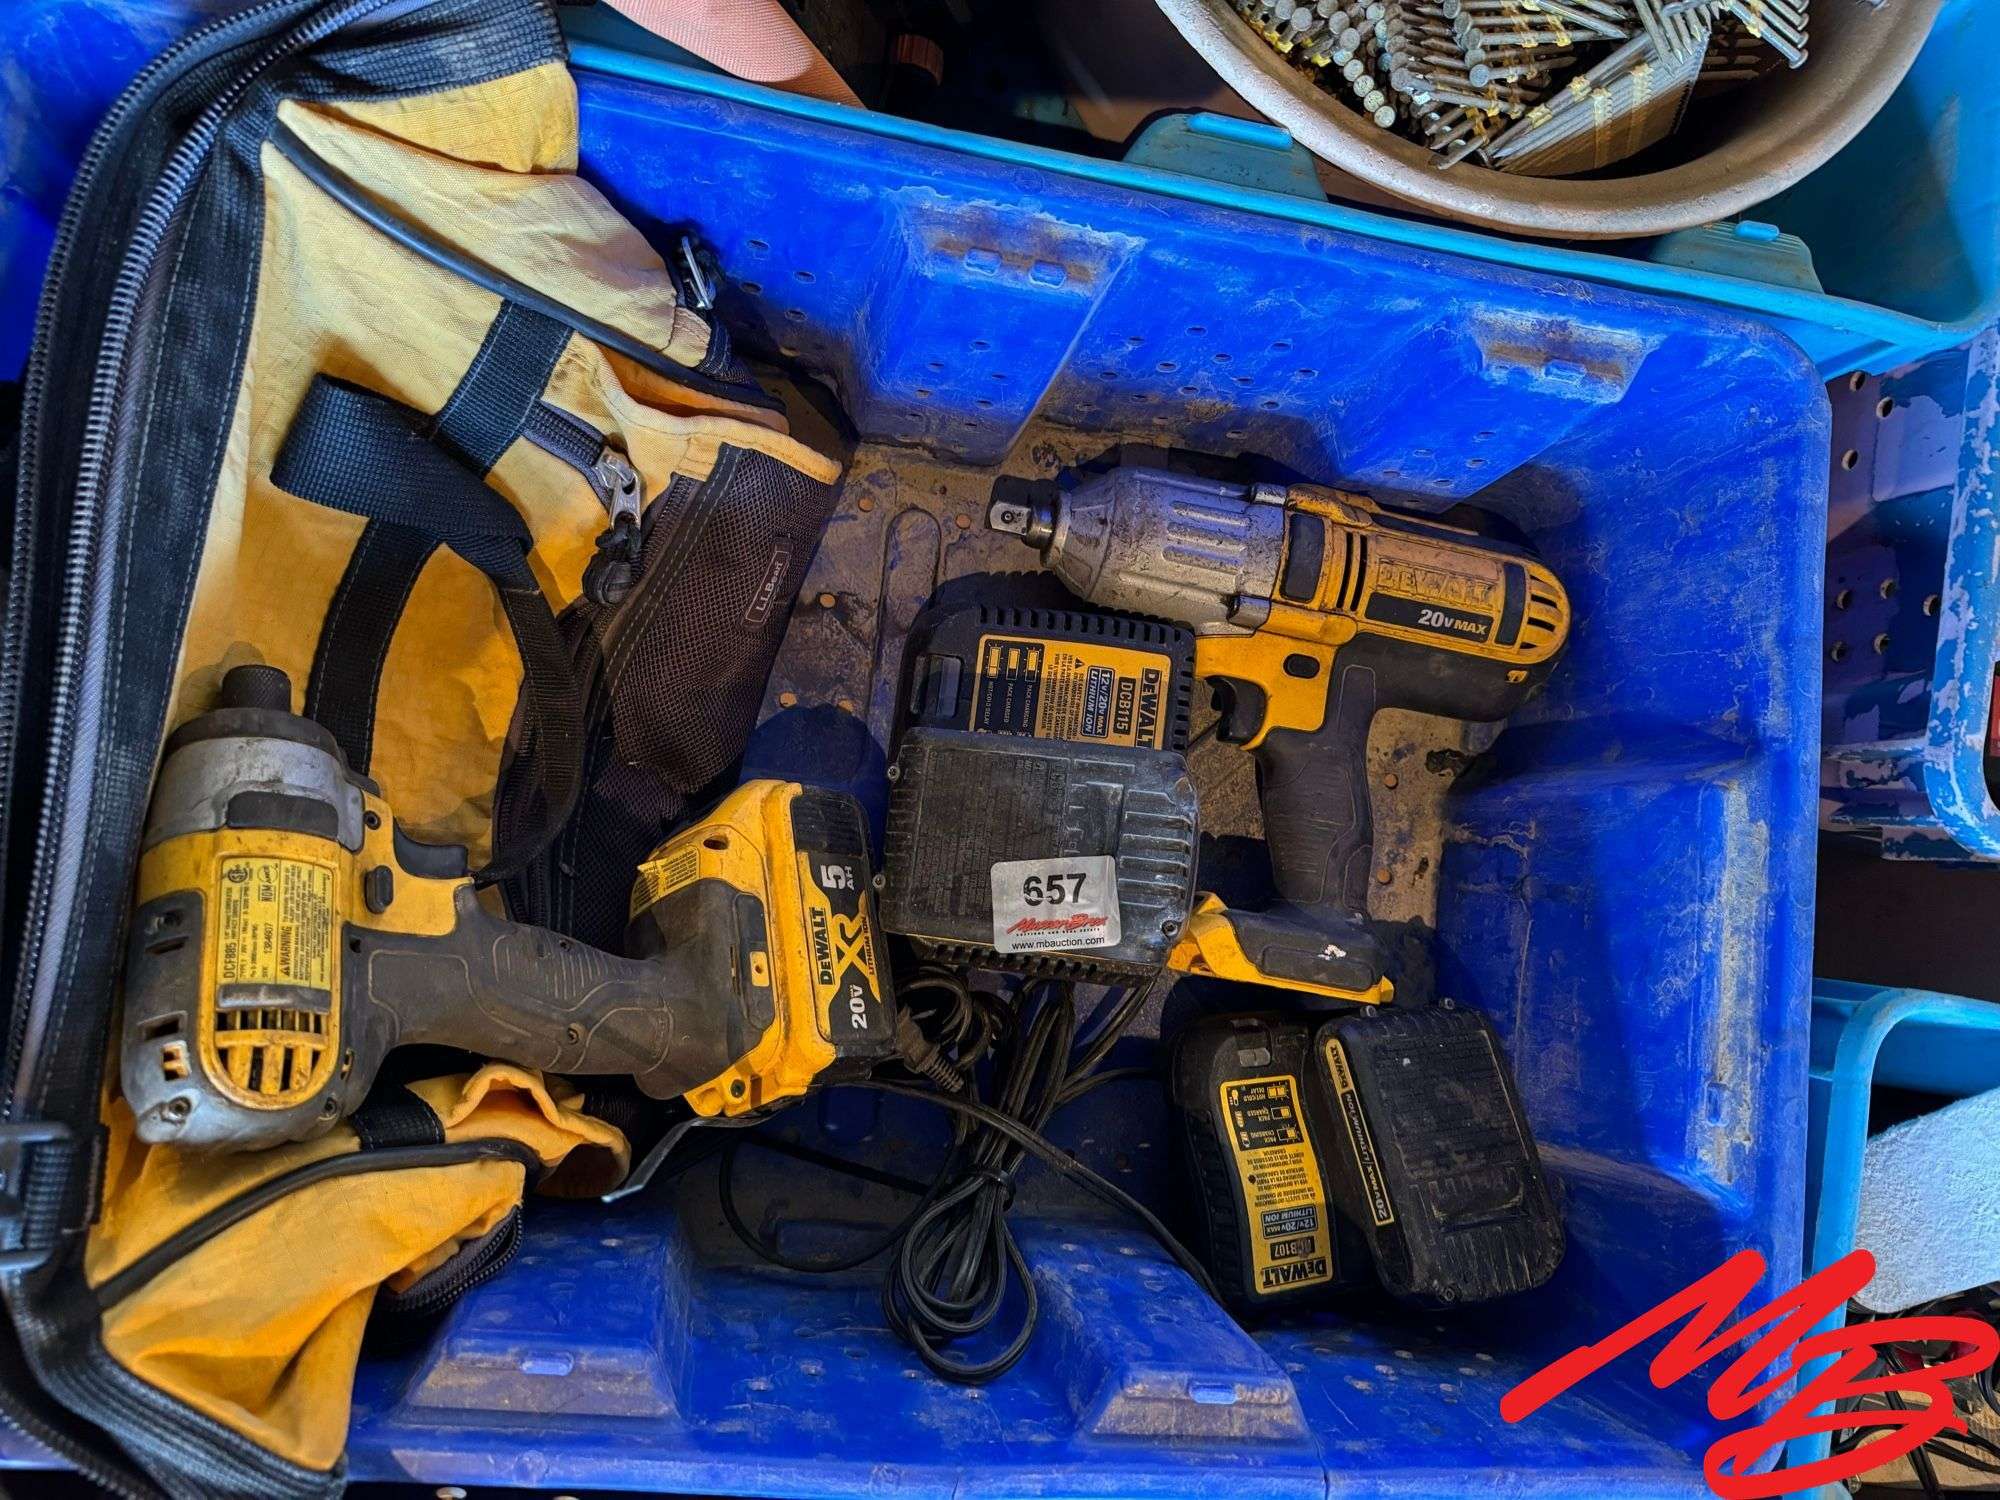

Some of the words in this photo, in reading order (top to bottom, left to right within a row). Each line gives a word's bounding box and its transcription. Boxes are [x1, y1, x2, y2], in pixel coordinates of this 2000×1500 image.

[1454, 620, 1487, 634] MAX
[1087, 671, 1098, 711] LITHIUM
[1117, 682, 1131, 730] DCB115
[1084, 713, 1093, 732] ION
[1096, 715, 1104, 734] MAX
[820, 864, 846, 889] 5
[1023, 872, 1087, 906] 657
[860, 916, 869, 935] ION
[280, 926, 292, 967] WARNING
[812, 907, 832, 985] DEWALT
[863, 935, 875, 975] LITHIUM
[1011, 937, 1105, 950] www.mbauction.com
[224, 942, 237, 979] DCF885
[1330, 1045, 1348, 1088] DEWALT
[1265, 1213, 1279, 1222] ION
[1281, 1208, 1313, 1220] LITHIUM
[1262, 1258, 1327, 1286] DEWALT
